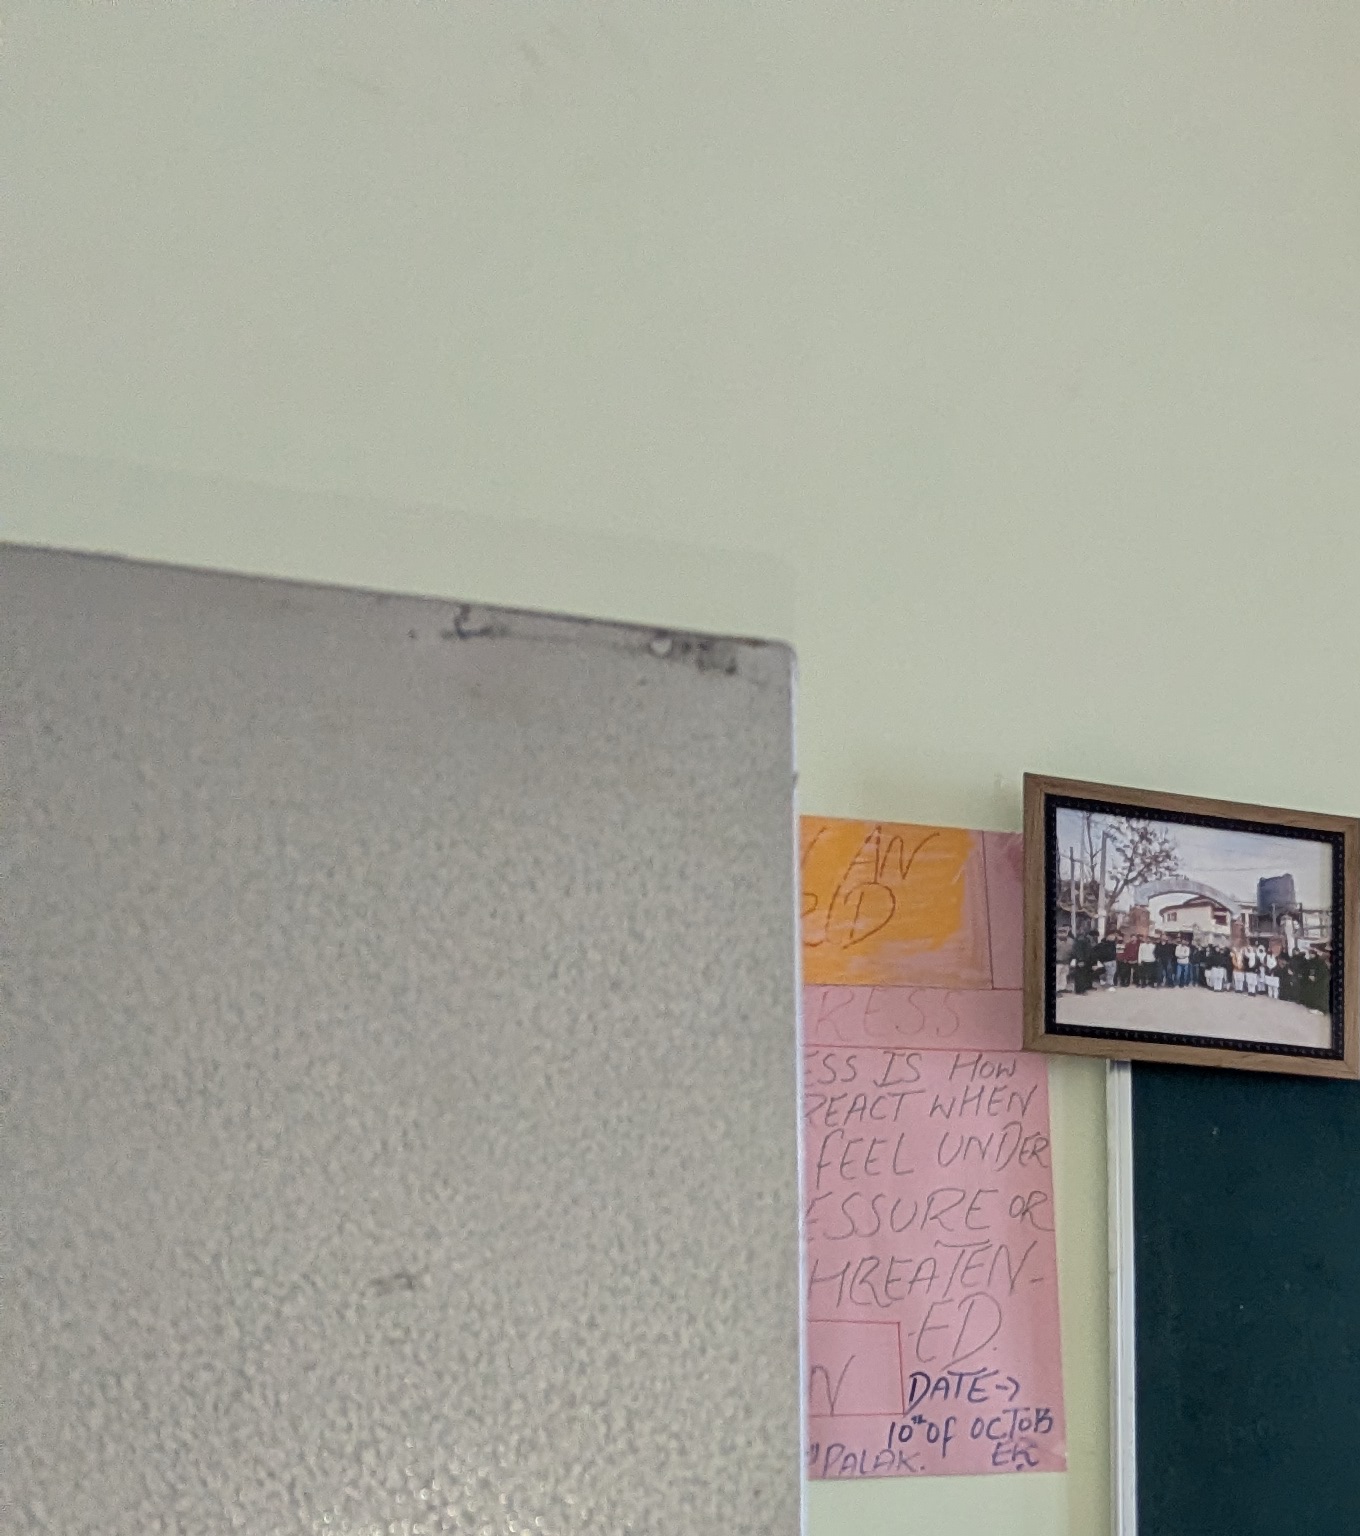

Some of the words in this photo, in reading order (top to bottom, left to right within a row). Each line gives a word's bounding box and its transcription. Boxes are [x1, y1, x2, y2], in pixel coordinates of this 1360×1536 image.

[874, 1050, 922, 1087] IS
[816, 1128, 914, 1190] FEEL
[937, 1121, 1050, 1172] UNDER
[1009, 1190, 1055, 1232] OR
